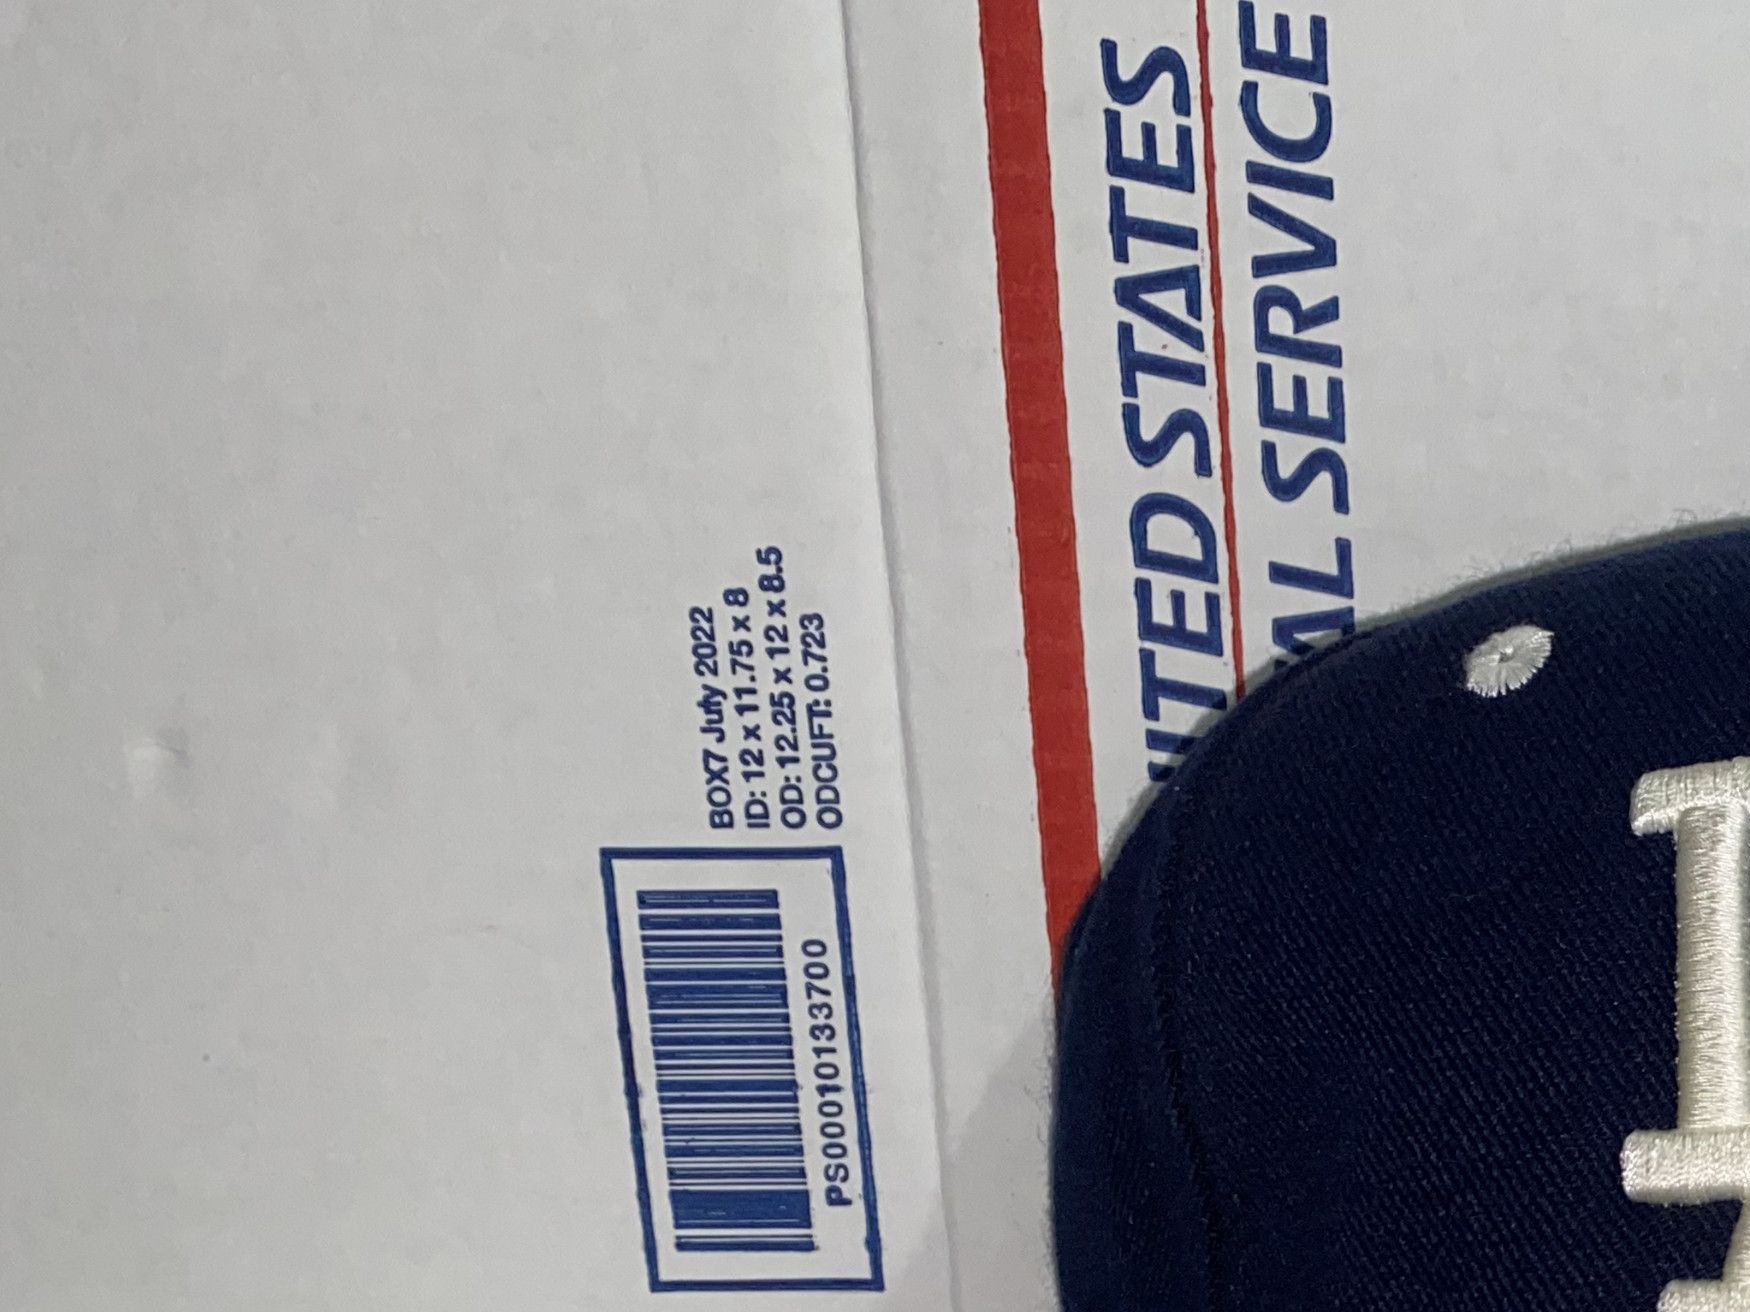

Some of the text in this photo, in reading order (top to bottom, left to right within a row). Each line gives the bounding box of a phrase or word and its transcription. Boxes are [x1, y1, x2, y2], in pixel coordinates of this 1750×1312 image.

[1100, 37, 1213, 478] STATES
[1238, 0, 1350, 516] SERVICE
[688, 606, 735, 830] BOX7 July 2022
[722, 587, 771, 829] ID: 12 x 11.75 x 8
[755, 545, 807, 830] OD: 12.25 x 12 x 8.5
[798, 612, 844, 830] ODCUFT: 0.723
[800, 938, 854, 1208] PS00010133700
